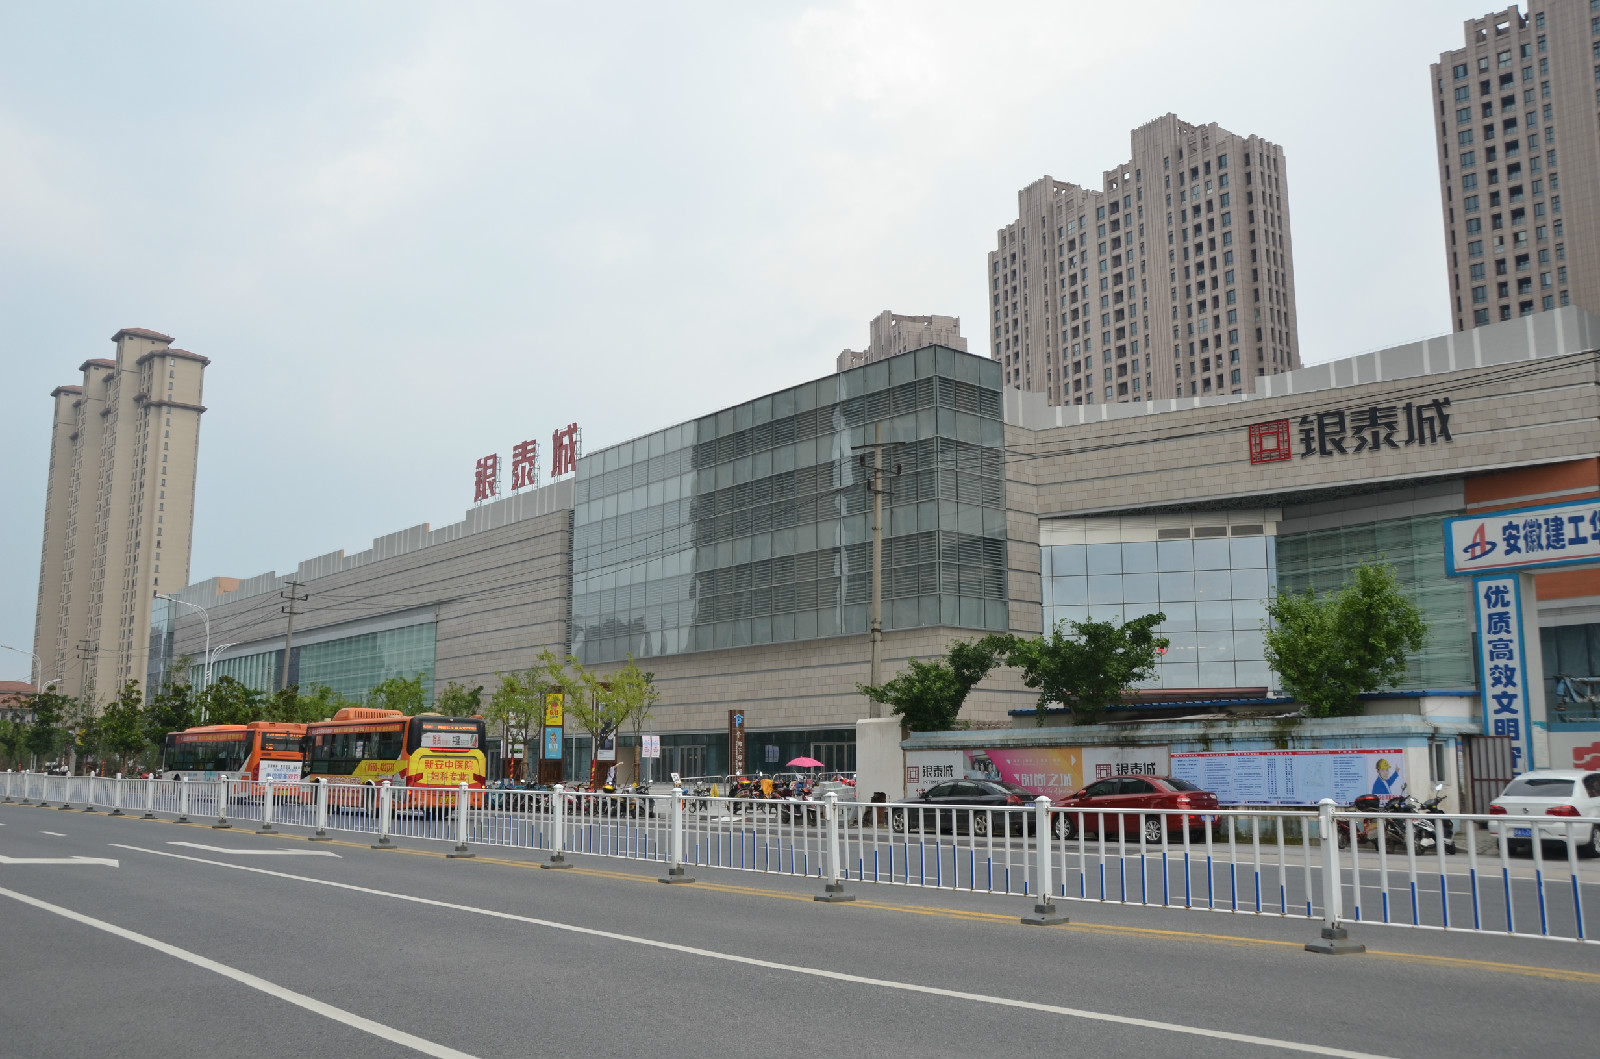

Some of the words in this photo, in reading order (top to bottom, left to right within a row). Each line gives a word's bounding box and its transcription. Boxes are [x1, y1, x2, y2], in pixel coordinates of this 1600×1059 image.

[1299, 397, 1453, 458] 银泰城
[474, 422, 578, 503] 银泰城
[1483, 584, 1522, 778] 优质高效文明
[424, 759, 474, 770] 新安中医院
[922, 764, 954, 778] 银泰城
[1116, 762, 1156, 776] 银泰城
[430, 771, 468, 782] 妇科专业
[1021, 773, 1073, 787] 时尚之城
